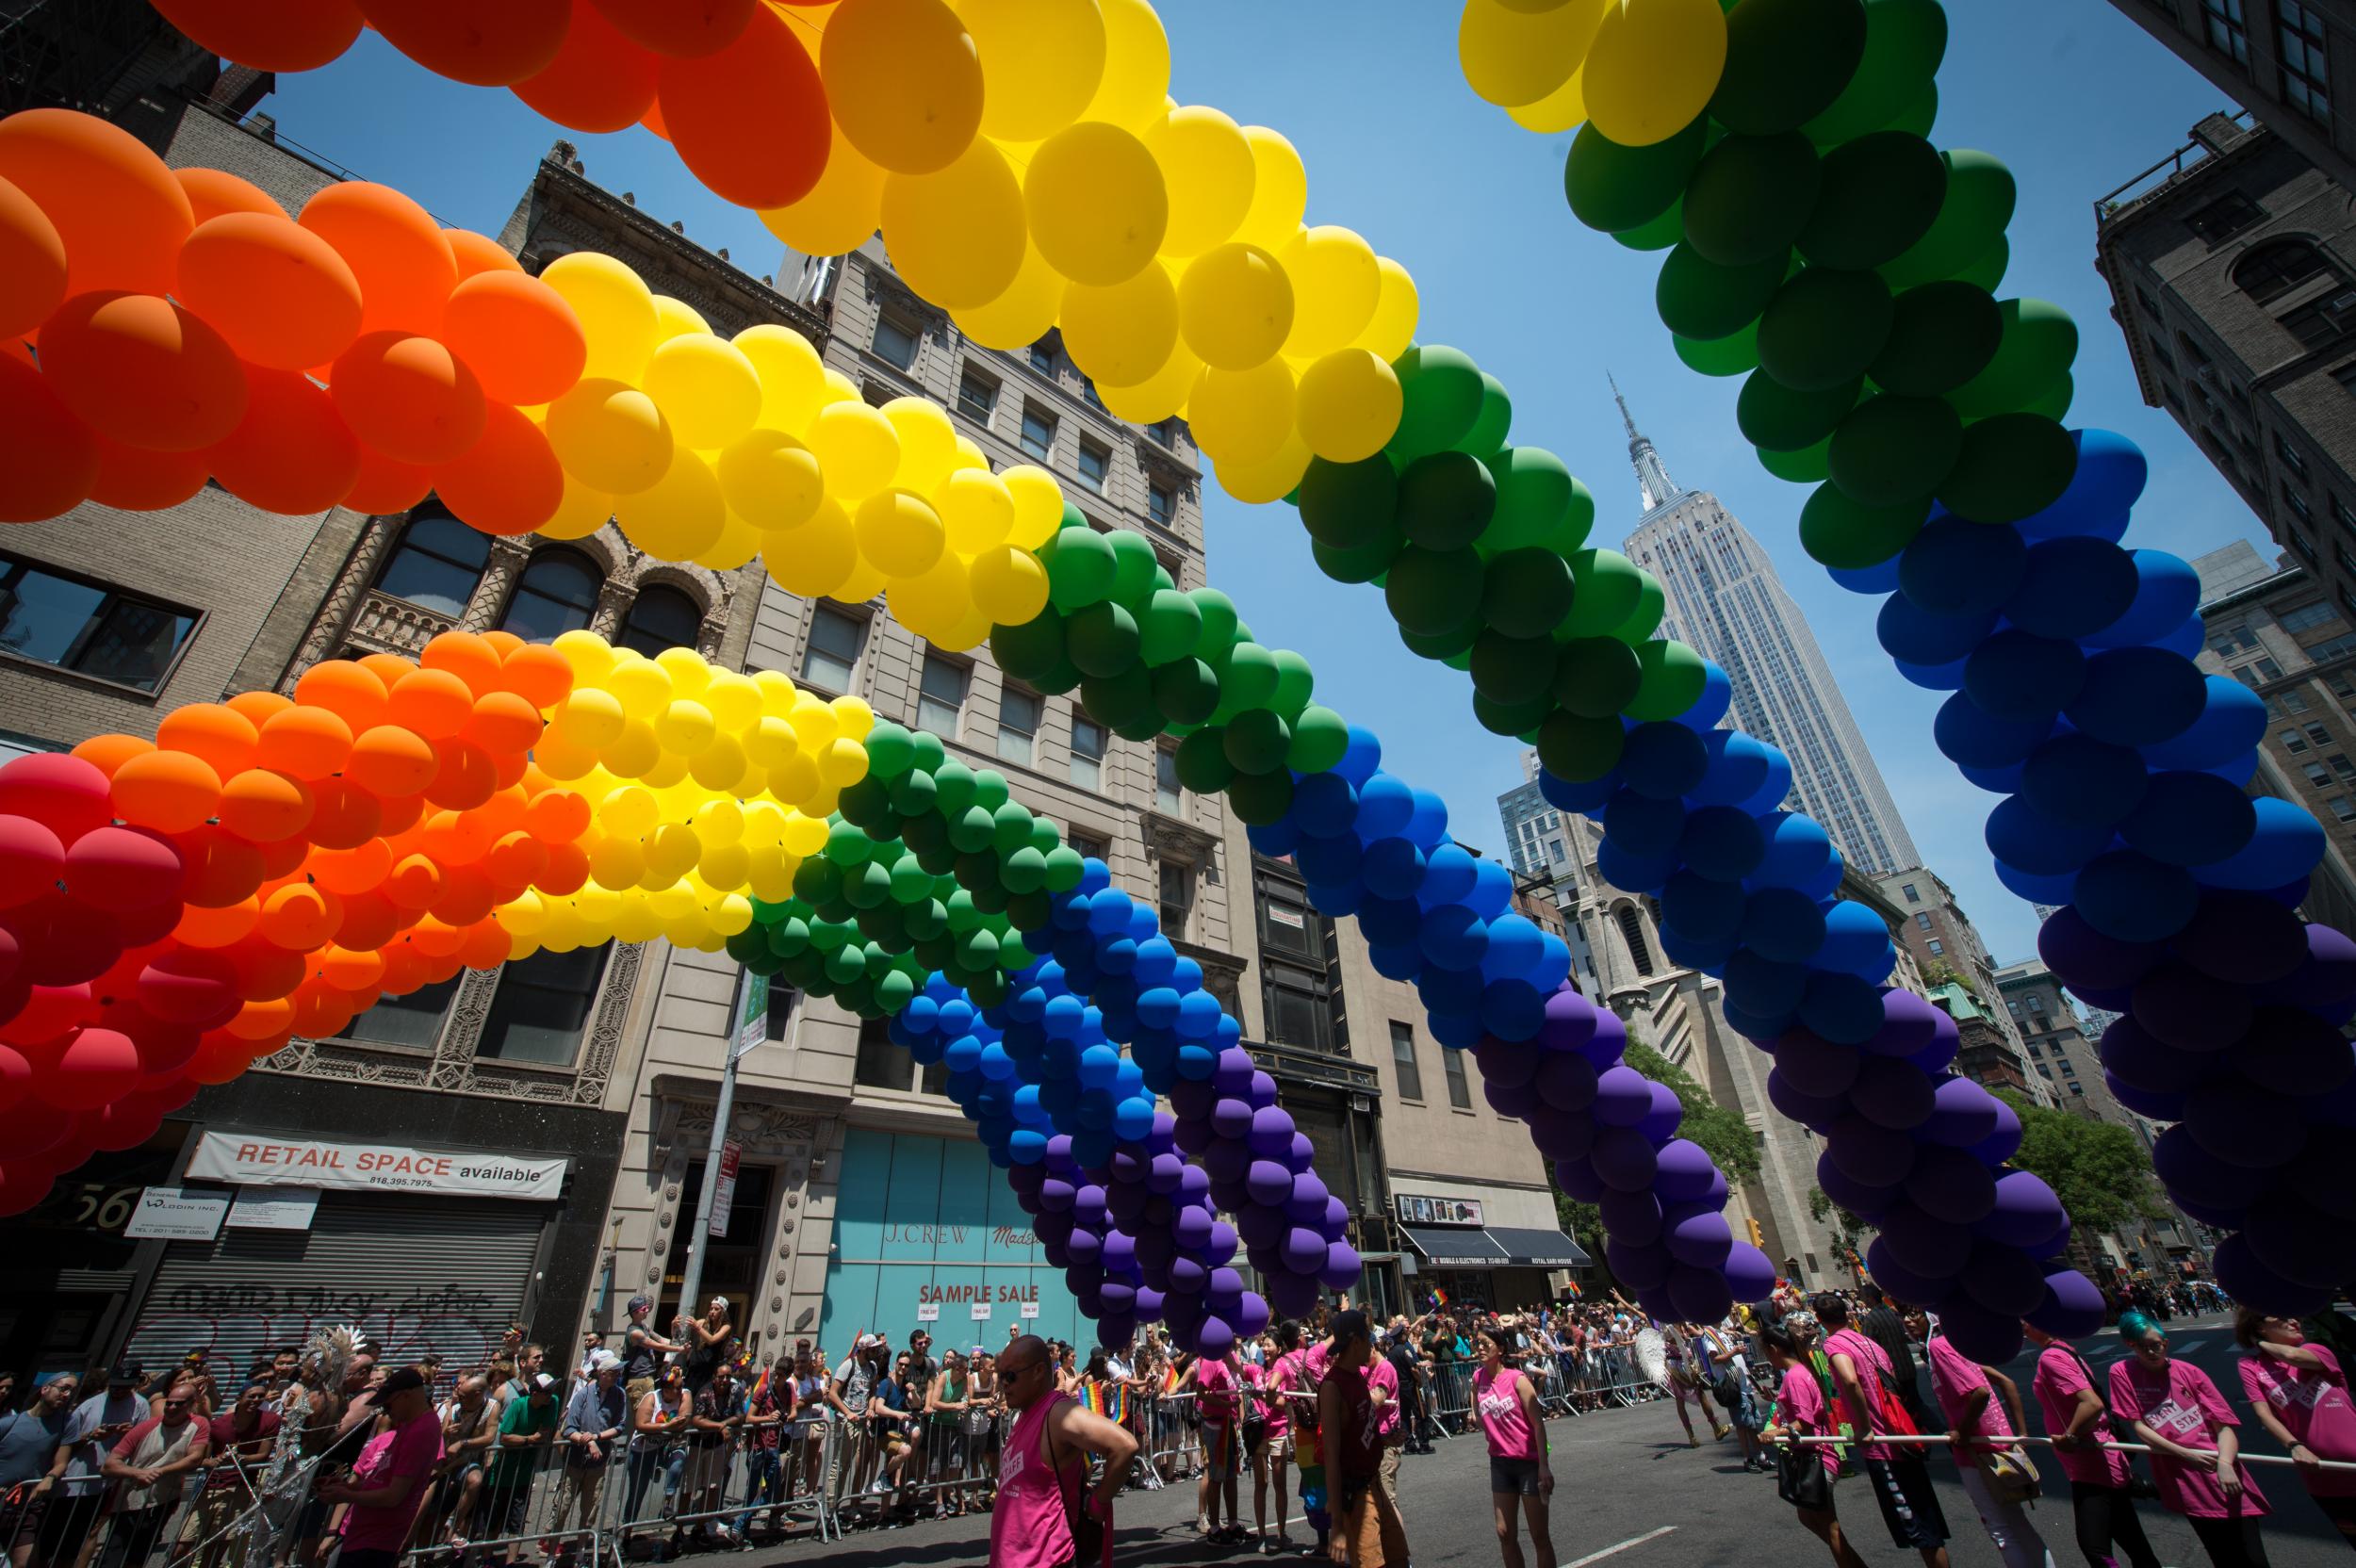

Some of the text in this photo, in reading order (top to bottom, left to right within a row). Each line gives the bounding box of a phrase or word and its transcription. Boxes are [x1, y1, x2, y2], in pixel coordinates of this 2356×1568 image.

[236, 1143, 542, 1184] RETAIL SPACE available
[369, 1174, 434, 1187] 818.395.7975
[885, 1223, 971, 1245] J.CREW
[919, 1284, 1039, 1304] SAMPLE SALE
[2270, 1381, 2301, 1405] EVENT
[2146, 1402, 2178, 1426] EVENT
